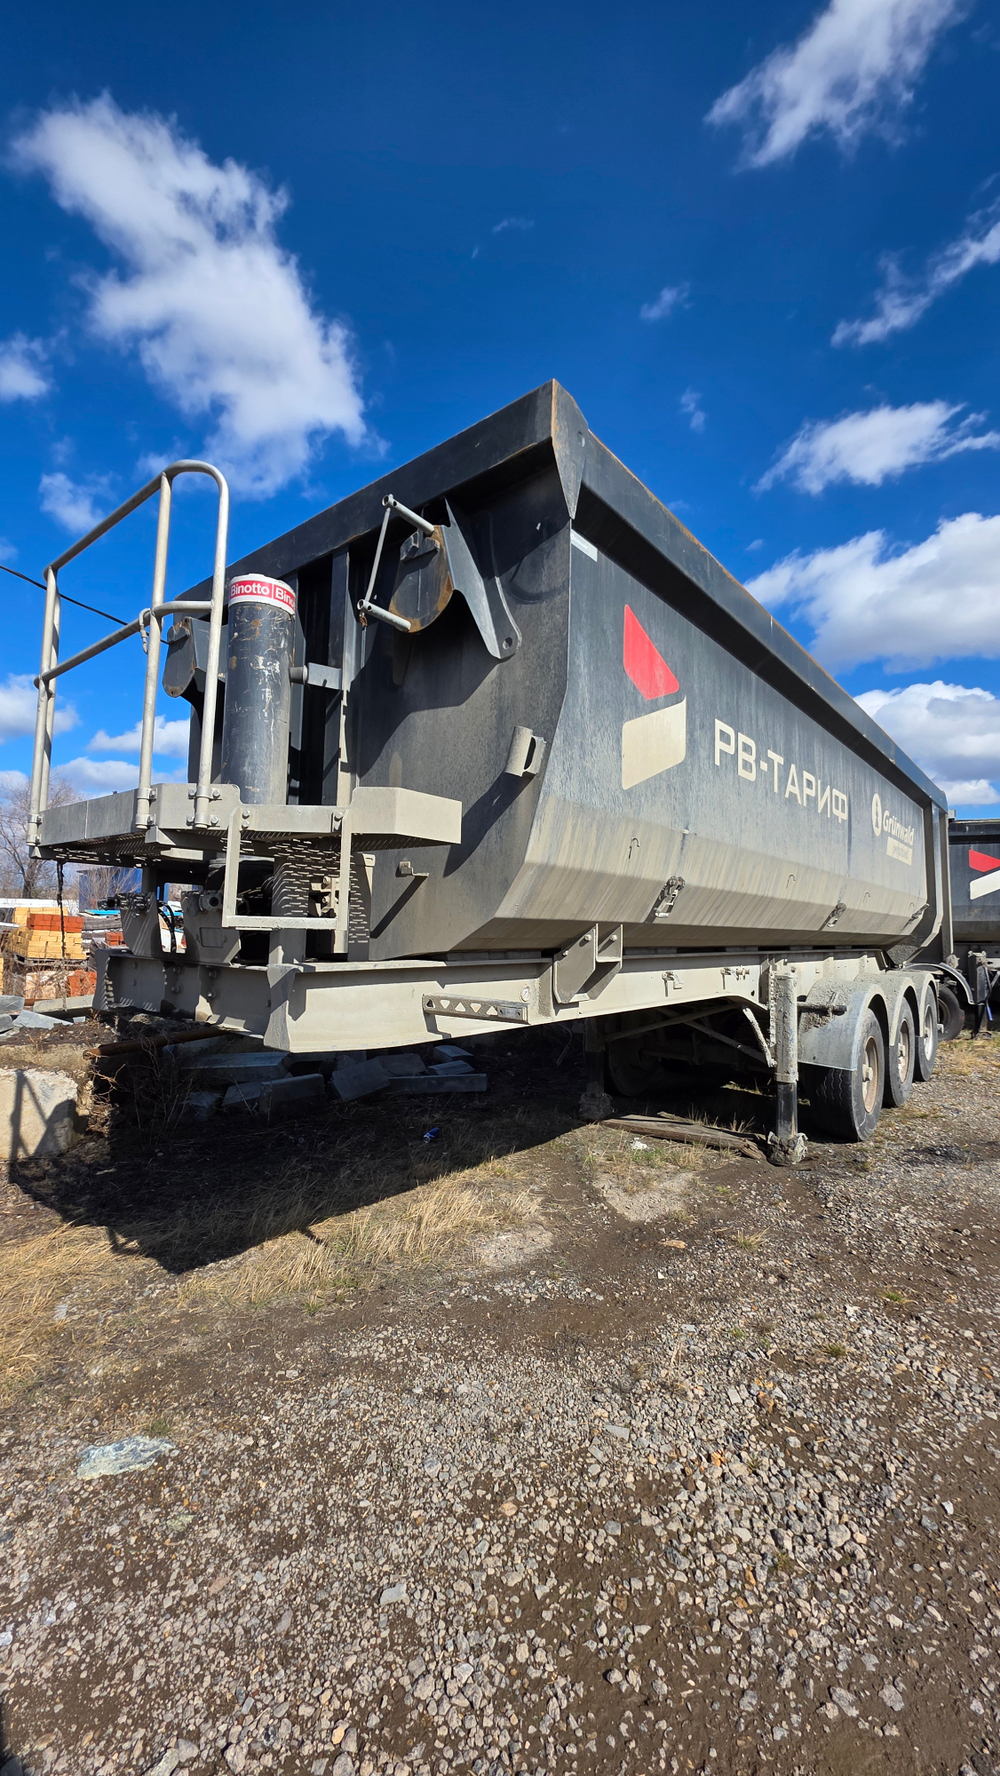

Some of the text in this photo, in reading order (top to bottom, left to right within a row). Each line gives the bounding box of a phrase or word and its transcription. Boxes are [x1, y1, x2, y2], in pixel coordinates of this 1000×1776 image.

[231, 583, 269, 596] Binotto
[715, 718, 848, 823] РВ-ТАРИФ
[883, 810, 914, 846] Grünwald
